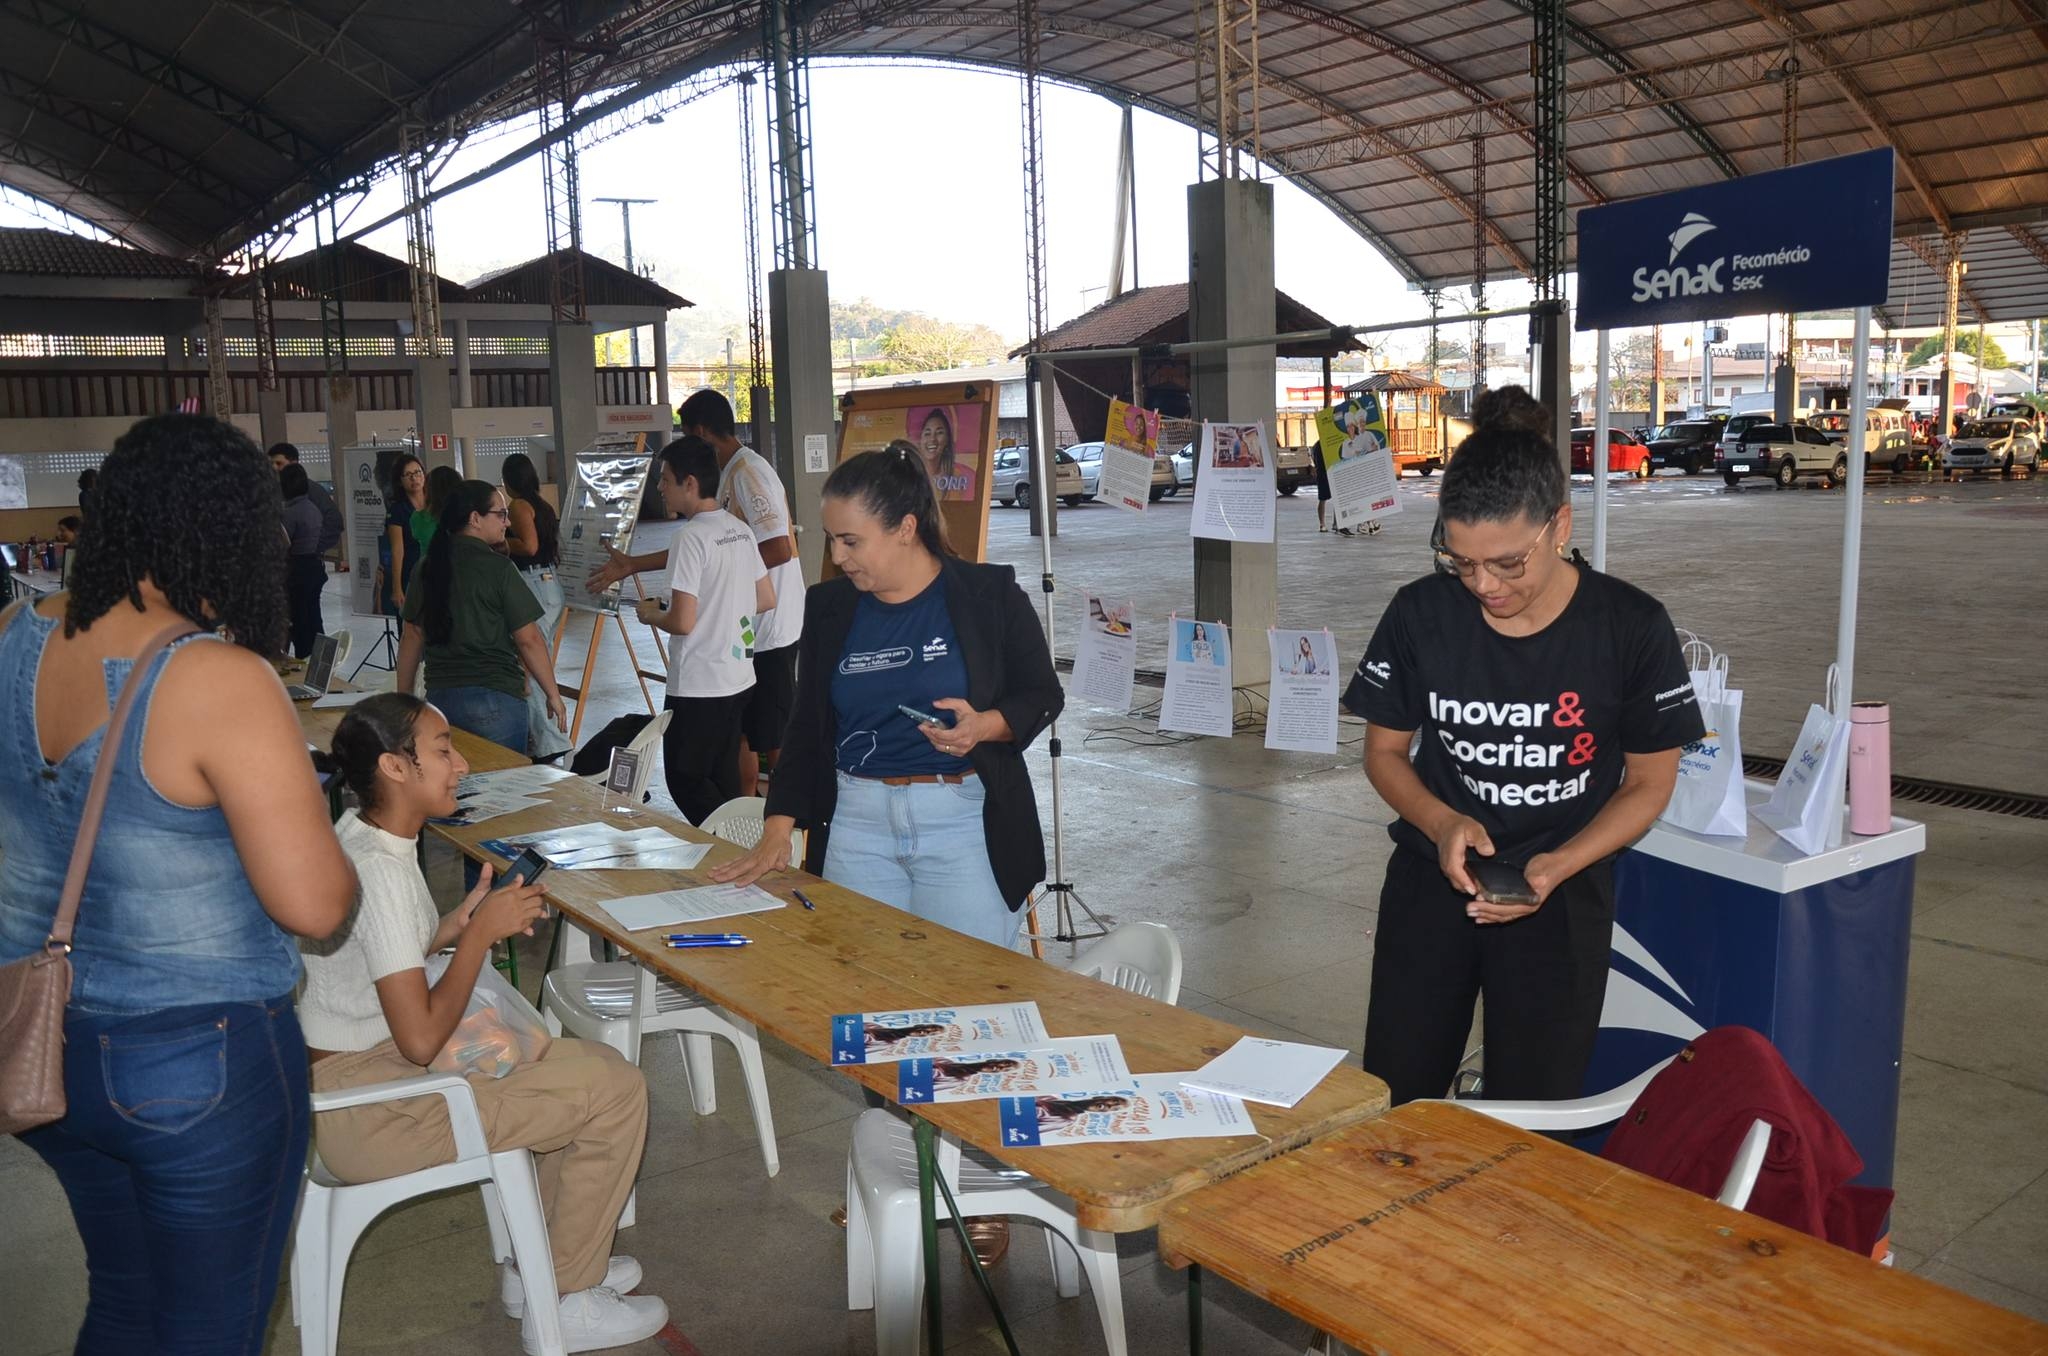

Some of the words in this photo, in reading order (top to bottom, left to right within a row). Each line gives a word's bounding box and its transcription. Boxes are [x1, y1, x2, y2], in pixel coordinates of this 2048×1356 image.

[1732, 245, 1811, 271] Fecomércio
[1631, 256, 1725, 302] Senac
[1429, 691, 1549, 727] Inovar
[1552, 691, 1585, 727] &
[1438, 729, 1565, 767] Cocriar
[1567, 732, 1597, 765] &
